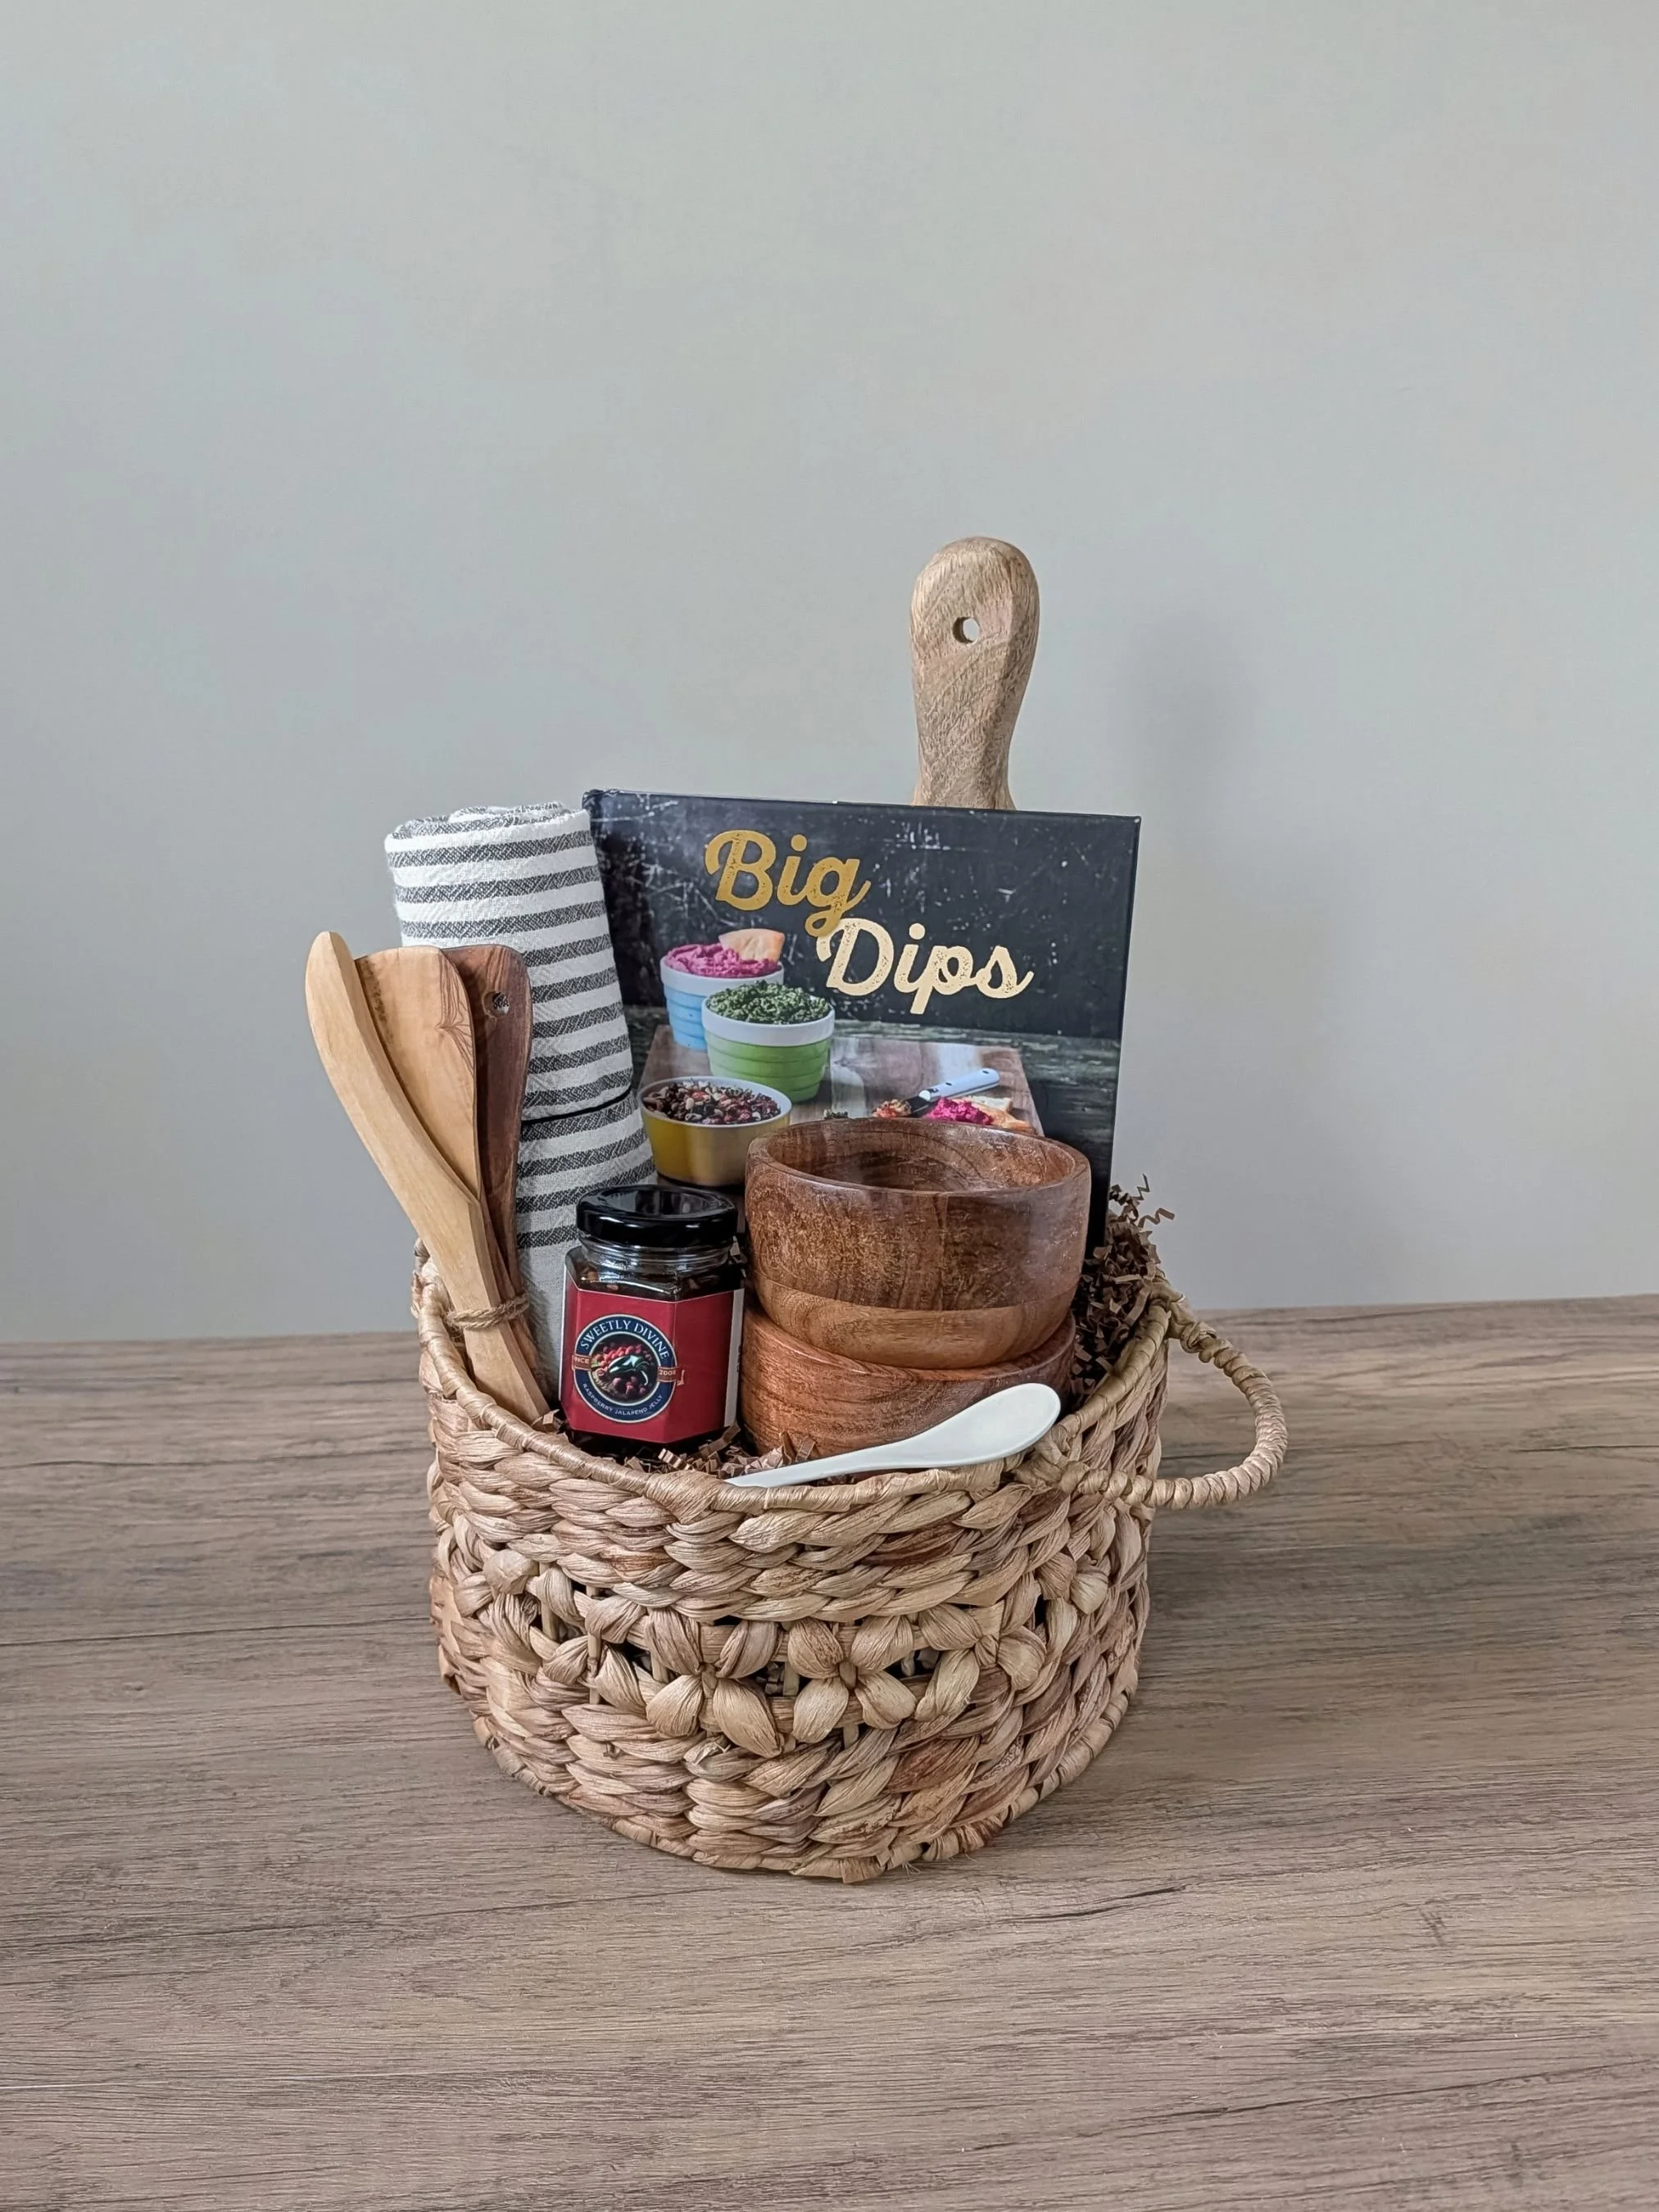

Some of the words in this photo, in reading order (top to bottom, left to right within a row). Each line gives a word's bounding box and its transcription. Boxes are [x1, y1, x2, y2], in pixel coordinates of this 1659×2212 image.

[705, 830, 870, 937] Big
[815, 918, 1033, 1014] Dips
[580, 1320, 631, 1349] SWEETLY
[633, 1323, 669, 1359] DIVINE
[582, 1383, 613, 1412] RASPBERRY
[649, 1394, 663, 1409] JELLY
